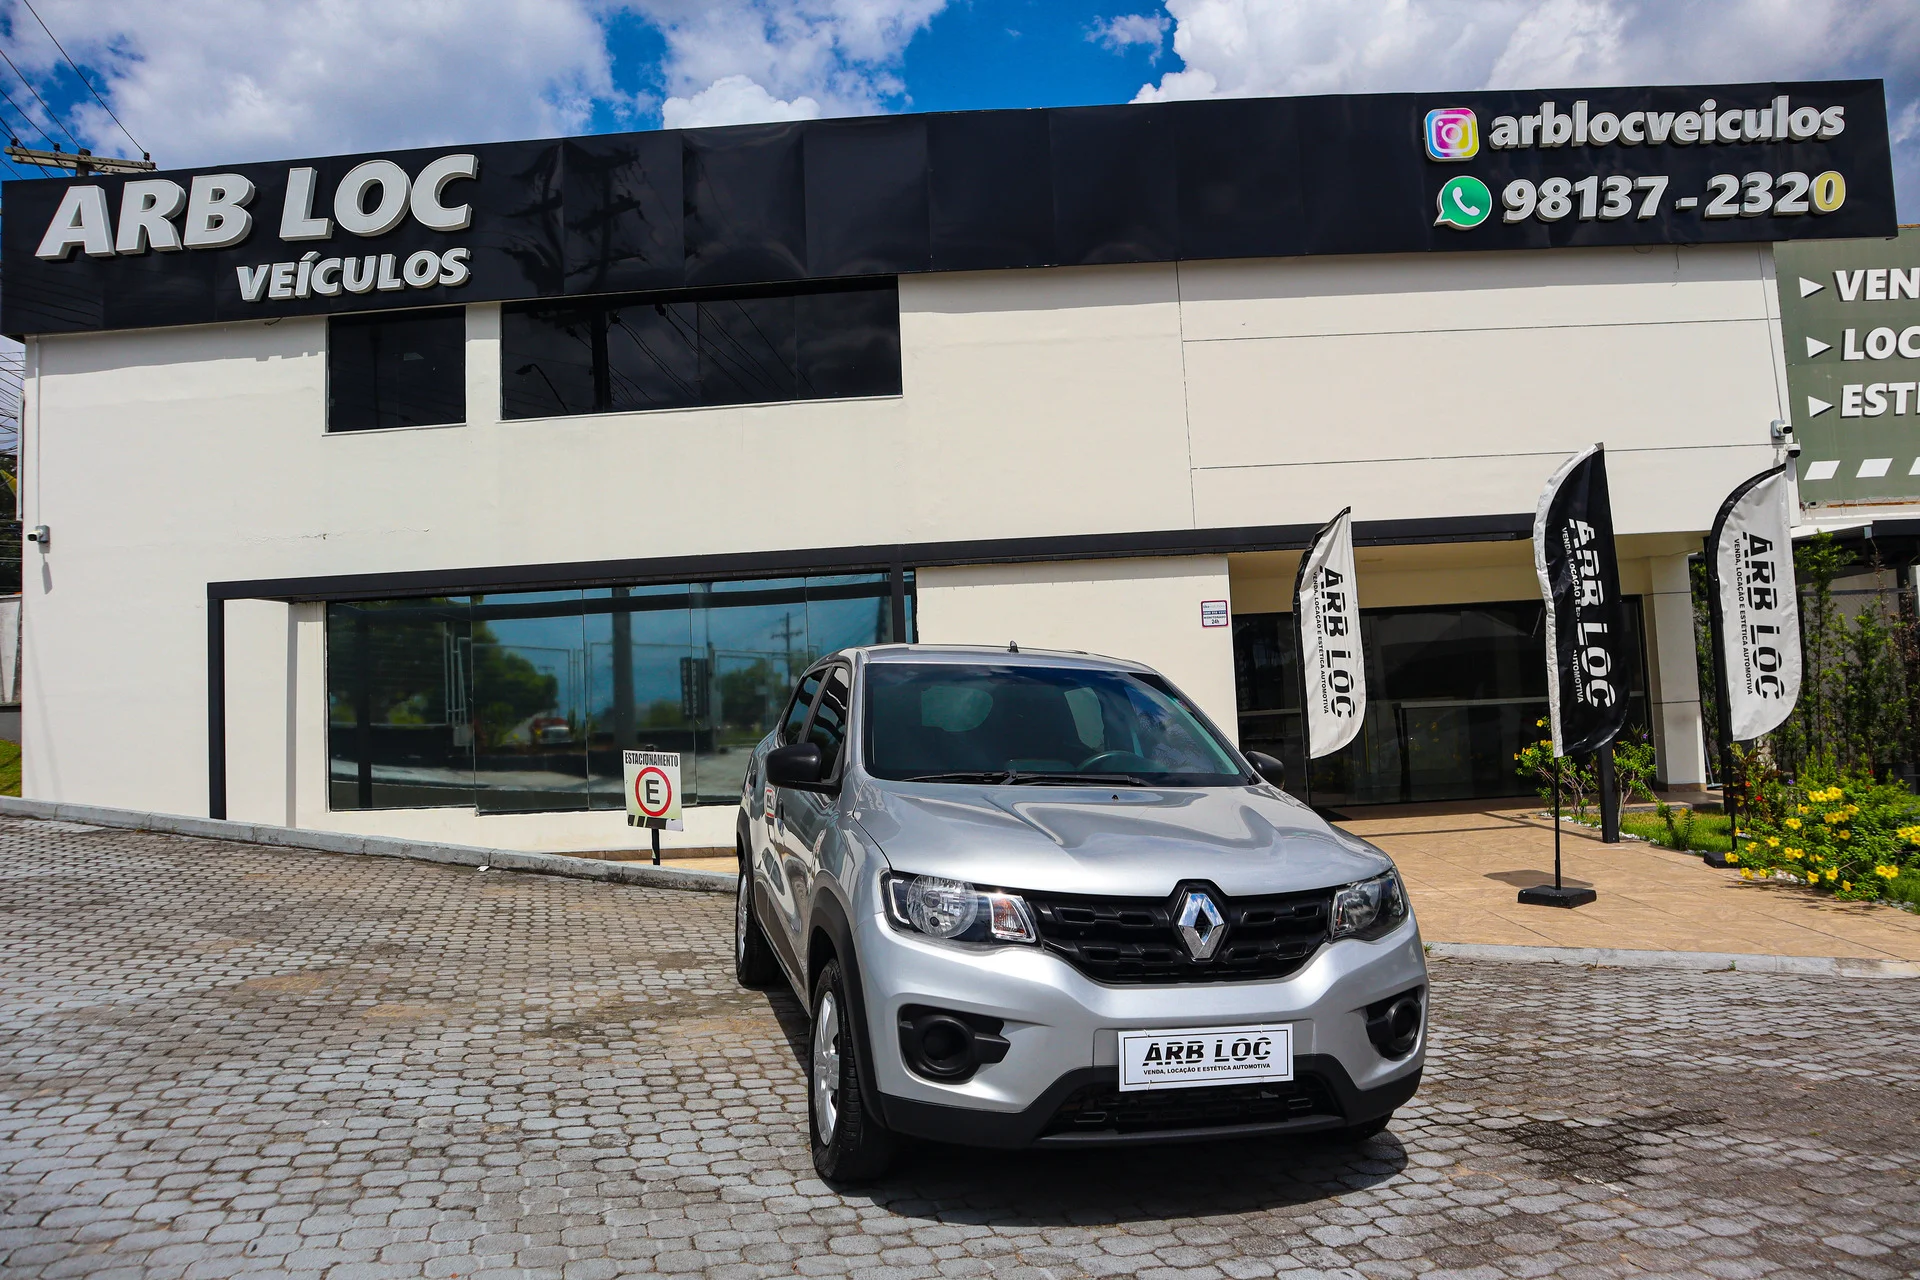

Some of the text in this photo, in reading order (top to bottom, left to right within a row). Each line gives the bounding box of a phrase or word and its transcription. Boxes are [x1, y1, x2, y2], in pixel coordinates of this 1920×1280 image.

[1489, 95, 1845, 150] arblocveiculos
[35, 153, 478, 261] ARB LOC
[1502, 175, 1668, 223] 98137
[1705, 171, 1846, 218] 2320
[236, 247, 471, 302] VEÍCULOS
[1834, 267, 1920, 301] VEN
[1842, 325, 1920, 361] LOC
[1841, 381, 1920, 418] EST
[1736, 567, 1745, 601] LOCAÇÃO
[1568, 518, 1616, 708] ARB LOC
[1740, 610, 1748, 645] ESTÉTICA
[1742, 531, 1785, 700] ARB LOC
[1319, 565, 1356, 718] ARB LOC
[1743, 647, 1753, 695] AUTOMOTIVA
[1321, 670, 1329, 714] AUTOMOTIVA
[625, 753, 679, 767] ESTACIONAMENTO
[646, 779, 660, 804] E
[1142, 1037, 1272, 1067] ARB LOC
[1167, 1066, 1195, 1074] LOCAÇÃO
[1202, 1064, 1231, 1072] ESTÉTICA
